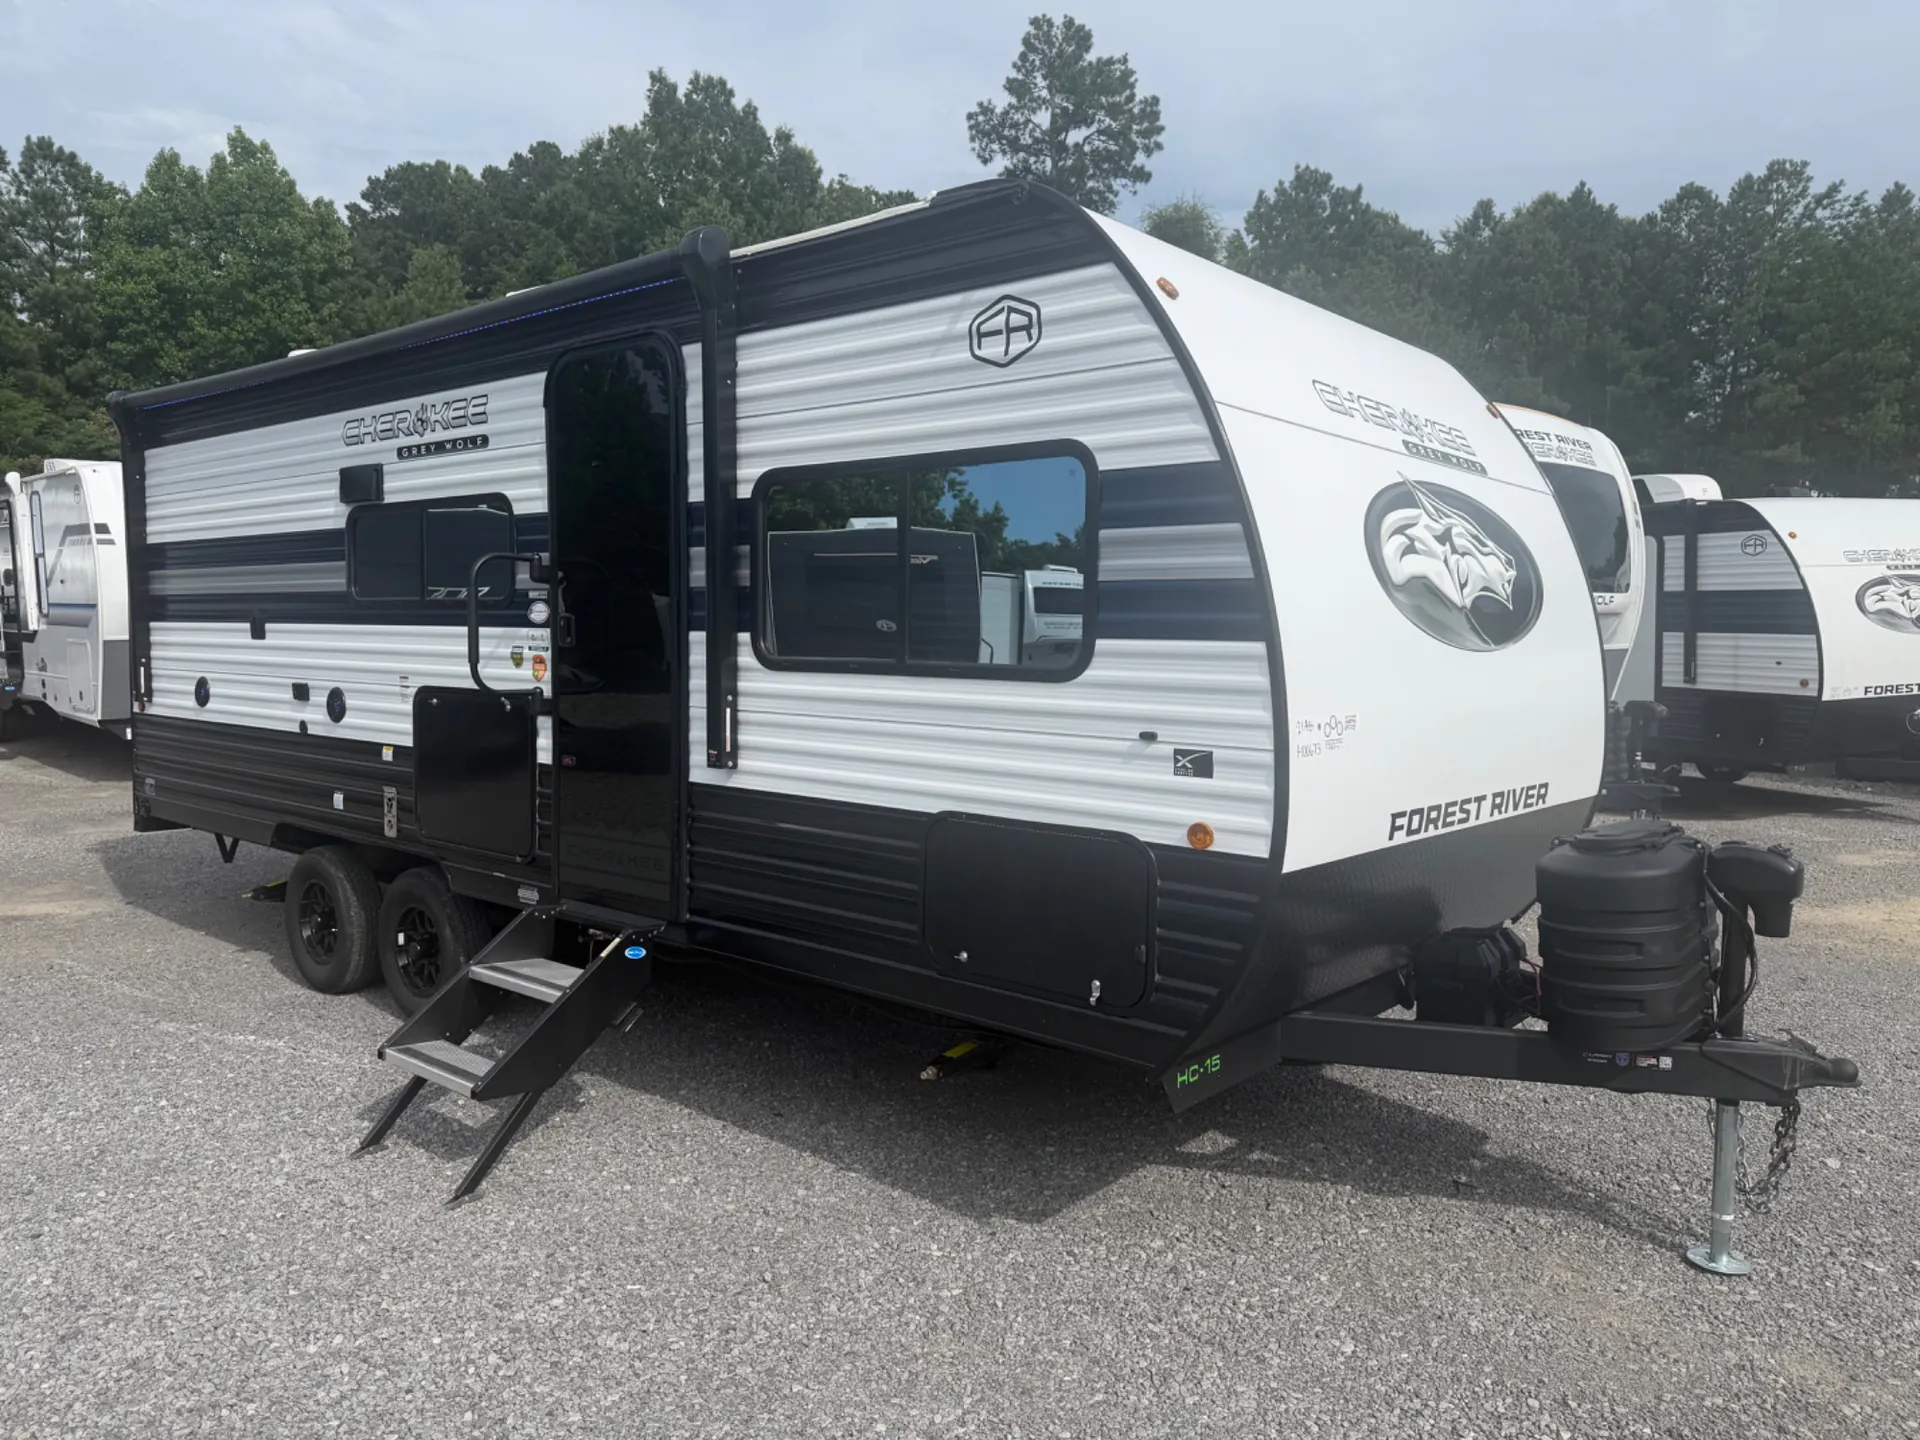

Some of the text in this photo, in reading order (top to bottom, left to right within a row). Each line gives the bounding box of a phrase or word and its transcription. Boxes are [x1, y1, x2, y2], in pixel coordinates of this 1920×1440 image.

[341, 394, 488, 446] CHEROKEE
[402, 437, 483, 457] GREY WOLF
[1513, 429, 1593, 452] REST RIVER
[1594, 595, 1615, 606] OLF
[1388, 782, 1549, 841] FOREST RIVER
